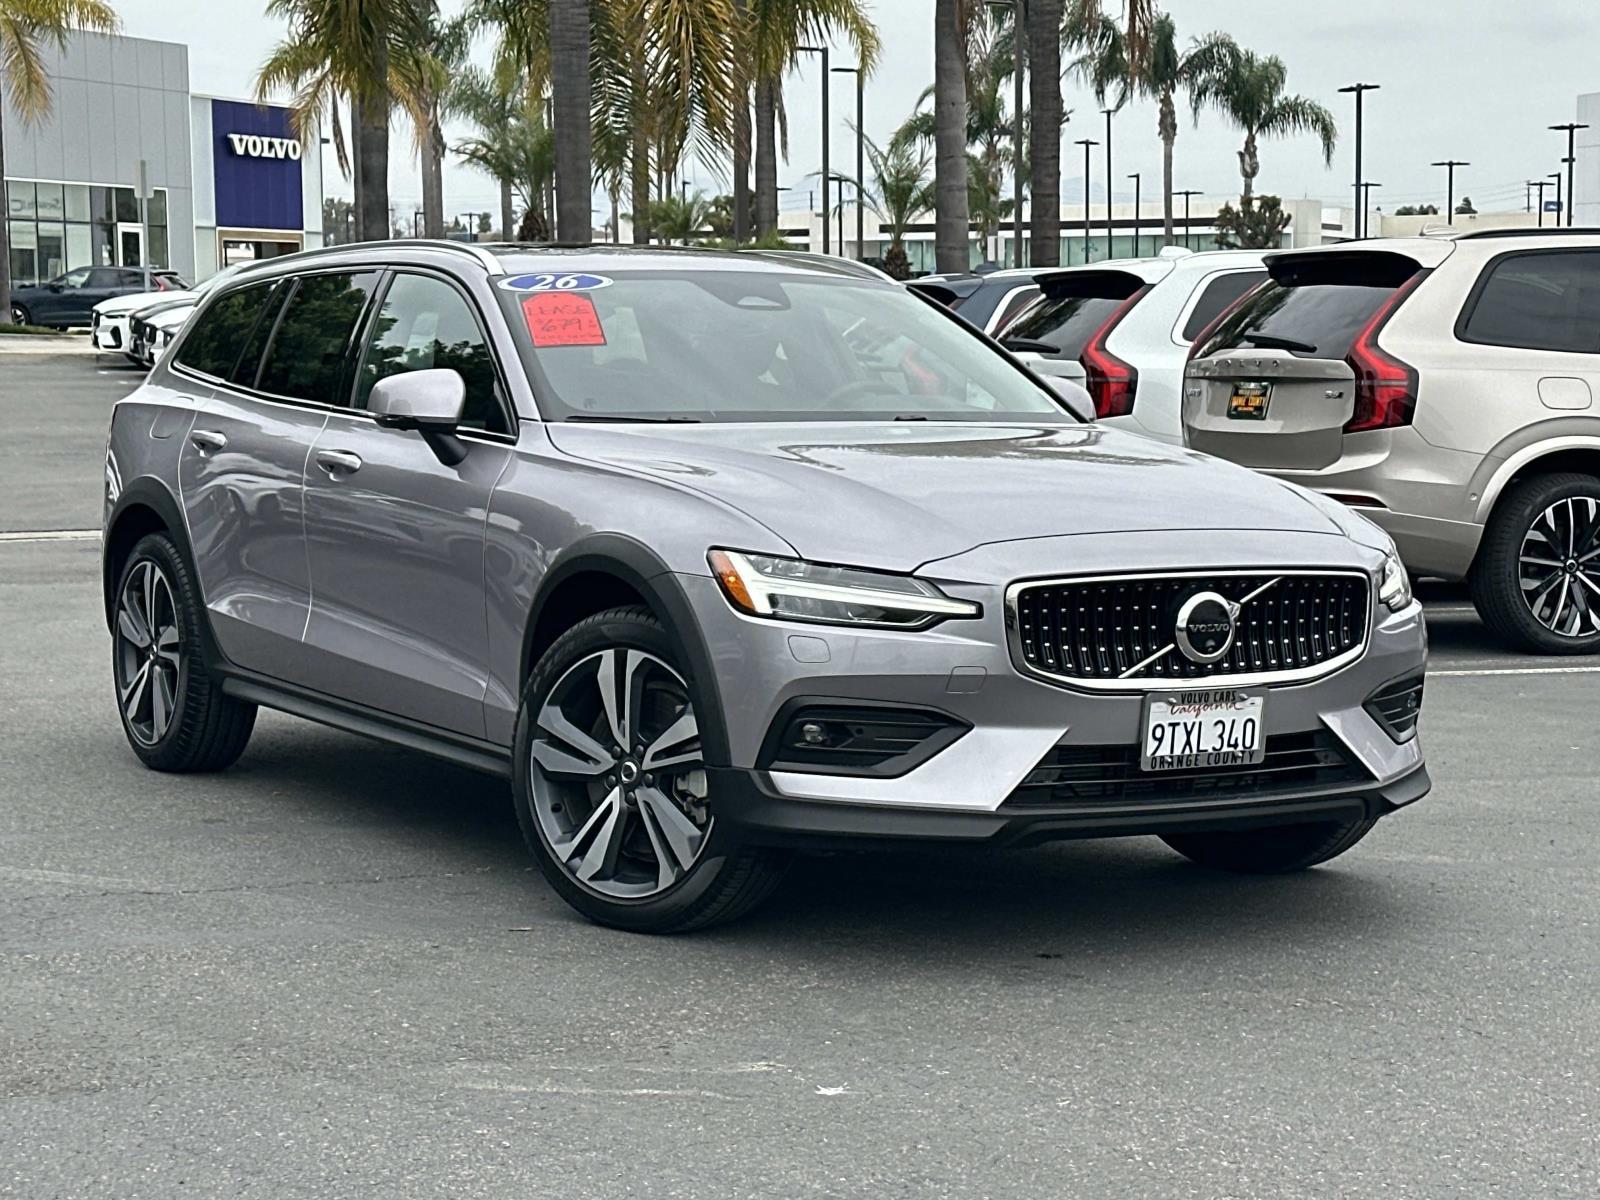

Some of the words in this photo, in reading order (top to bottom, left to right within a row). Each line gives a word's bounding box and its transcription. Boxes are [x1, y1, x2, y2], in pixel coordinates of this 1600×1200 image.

[227, 133, 300, 160] VOLVO
[532, 275, 578, 289] 26
[1212, 359, 1280, 367] VOLVO
[1188, 623, 1230, 632] VOLVO
[1181, 692, 1210, 704] VOLVO
[1213, 690, 1238, 703] CARS
[1171, 702, 1244, 718] California
[1152, 718, 1256, 755] 9TXL340
[1207, 751, 1254, 765] COUNTY
